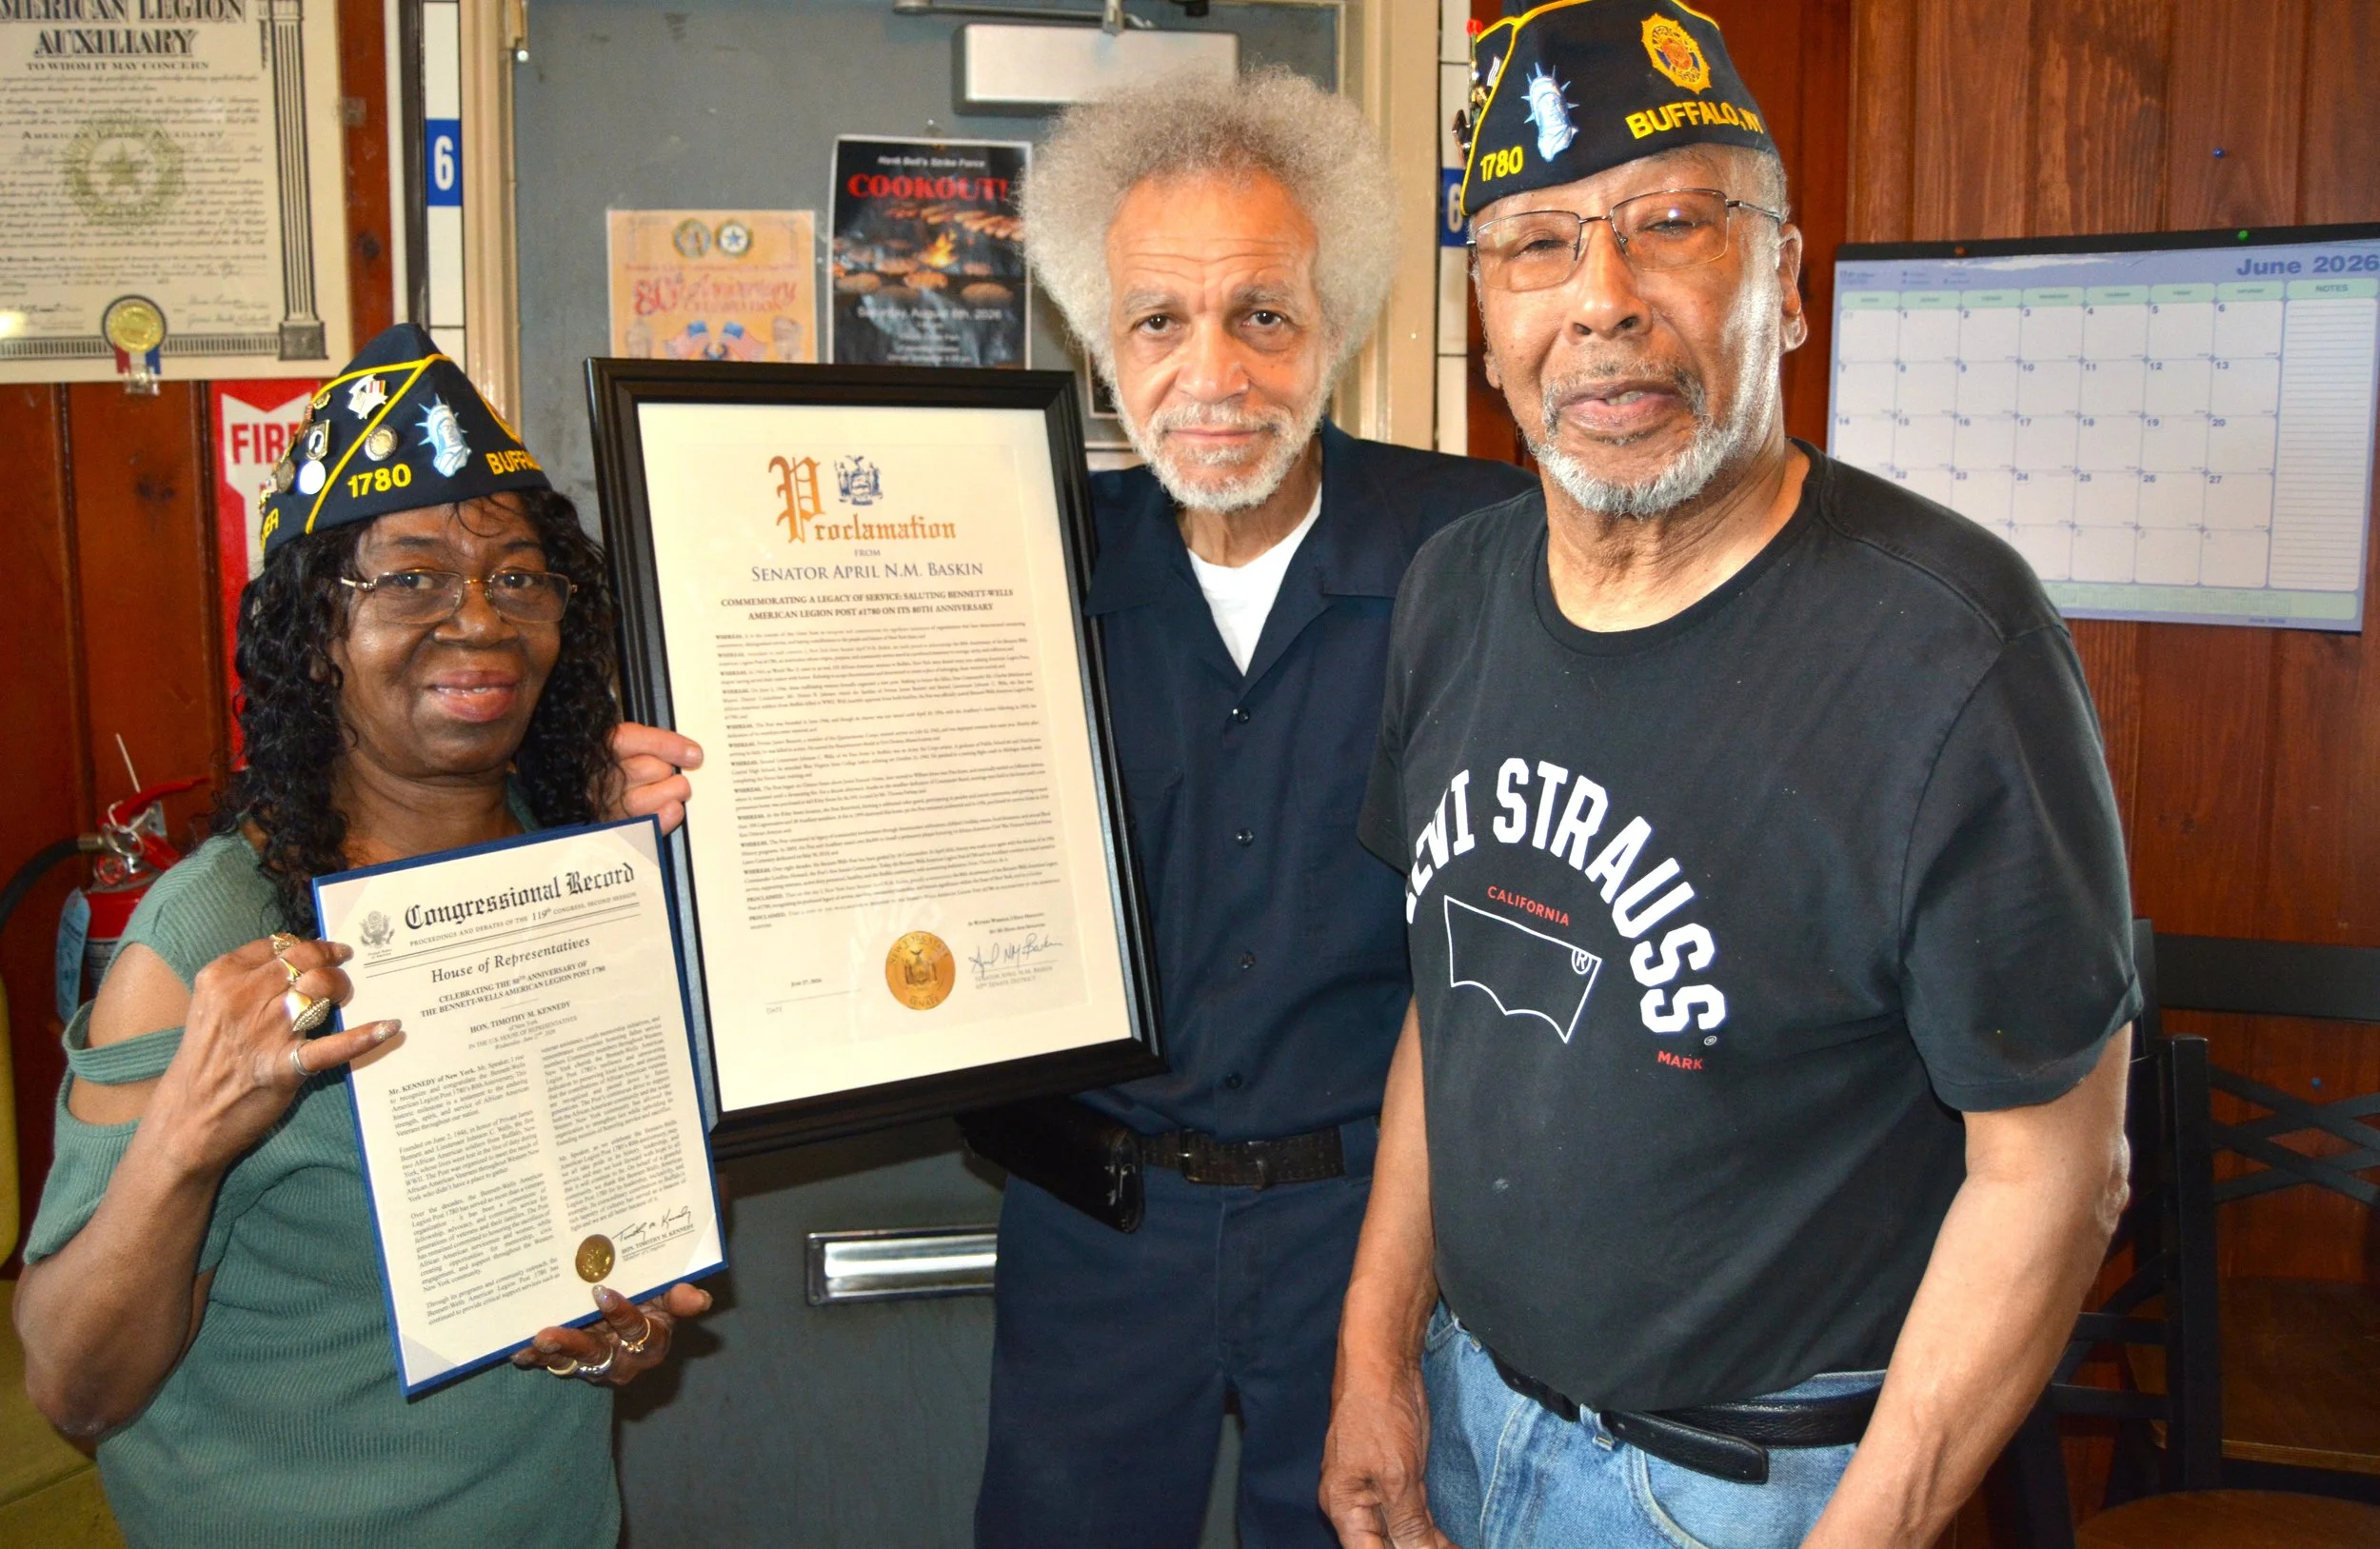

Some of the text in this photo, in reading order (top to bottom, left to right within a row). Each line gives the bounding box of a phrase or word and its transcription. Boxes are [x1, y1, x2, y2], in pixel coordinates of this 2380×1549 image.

[0, 0, 247, 23] MERICAN LEGION
[33, 28, 199, 58] AUXILIARY
[26, 61, 209, 71] TO WHOM IT MAY CONCERN
[433, 135, 455, 191] 6
[1479, 146, 1523, 182] 1780
[846, 172, 1008, 202] COOKOUT!
[1448, 183, 1463, 233] 6
[2236, 253, 2380, 276] June 2026
[2022, 364, 2033, 372] 10
[2150, 362, 2162, 370] 12
[2215, 361, 2229, 369] 13
[1958, 418, 1970, 427] 16
[2019, 418, 2031, 427] 17
[2082, 418, 2094, 427] 18
[347, 463, 411, 498] 1780
[2144, 475, 2155, 484] 26
[768, 455, 957, 544] Proclamation
[854, 548, 881, 557] FROM
[751, 562, 983, 582] SENATOR APRIL N.M. BASKIN
[721, 596, 807, 606] COMMEMORATING
[817, 594, 851, 604] LEGACY
[902, 591, 946, 601] SALUTING
[947, 588, 1014, 599] BENNETT-WELLS
[748, 610, 798, 621] AMERICAN
[800, 609, 834, 618] LEGION
[882, 606, 896, 615] ON
[936, 603, 993, 613] ANNIVERSARY
[405, 862, 635, 930] Congressional Record
[1487, 885, 1570, 927] CALIFORNIA
[1493, 757, 1728, 1034] STRAUSS
[409, 931, 458, 947] PROCEEDINGS
[459, 927, 474, 936] AND
[475, 921, 505, 933] DEBATES
[431, 938, 590, 983] House of Representatives
[421, 1007, 437, 1018] THE
[439, 992, 504, 1013] BENNETT-WELLS
[505, 981, 544, 997] AMERICAN
[544, 974, 572, 987] LEGION
[572, 968, 590, 980] POST
[438, 983, 495, 1003] CELEBRATING
[495, 980, 510, 989] THE
[527, 963, 576, 982] ANNIVERSARY
[577, 960, 587, 969] OF
[469, 1023, 489, 1034] HON.
[490, 1013, 526, 1028] TIMOTHY
[537, 1001, 570, 1016] KENNEDY
[1657, 1050, 1703, 1070] MARK
[402, 1078, 435, 1092] KENNEDY
